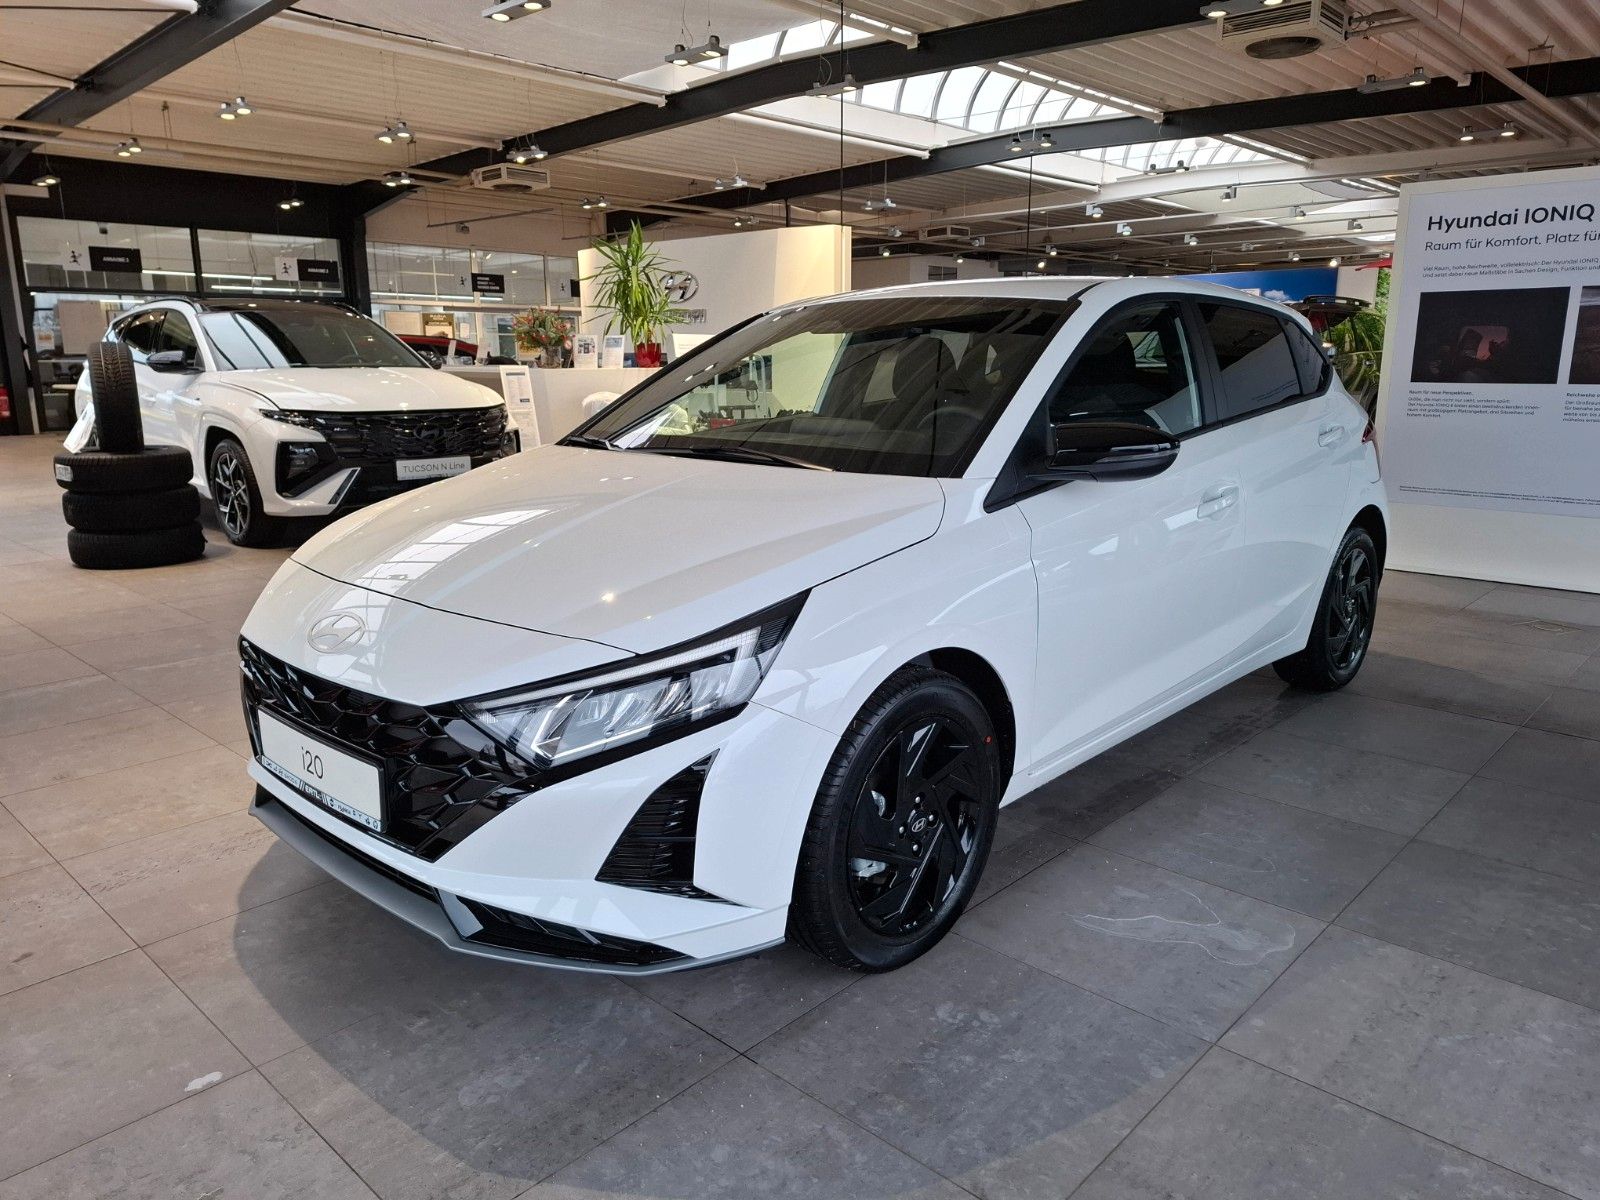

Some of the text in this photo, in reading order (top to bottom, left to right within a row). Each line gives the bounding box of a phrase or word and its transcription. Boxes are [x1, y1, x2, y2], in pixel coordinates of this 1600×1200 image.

[1428, 203, 1595, 233] Hyundai IONIQ
[1425, 241, 1461, 251] Raum
[1466, 238, 1482, 249] für
[1485, 235, 1541, 248] Komfort.
[1546, 233, 1580, 244] Platz
[403, 464, 439, 473] TUCSON
[449, 461, 466, 469] Line
[301, 746, 324, 779] i20
